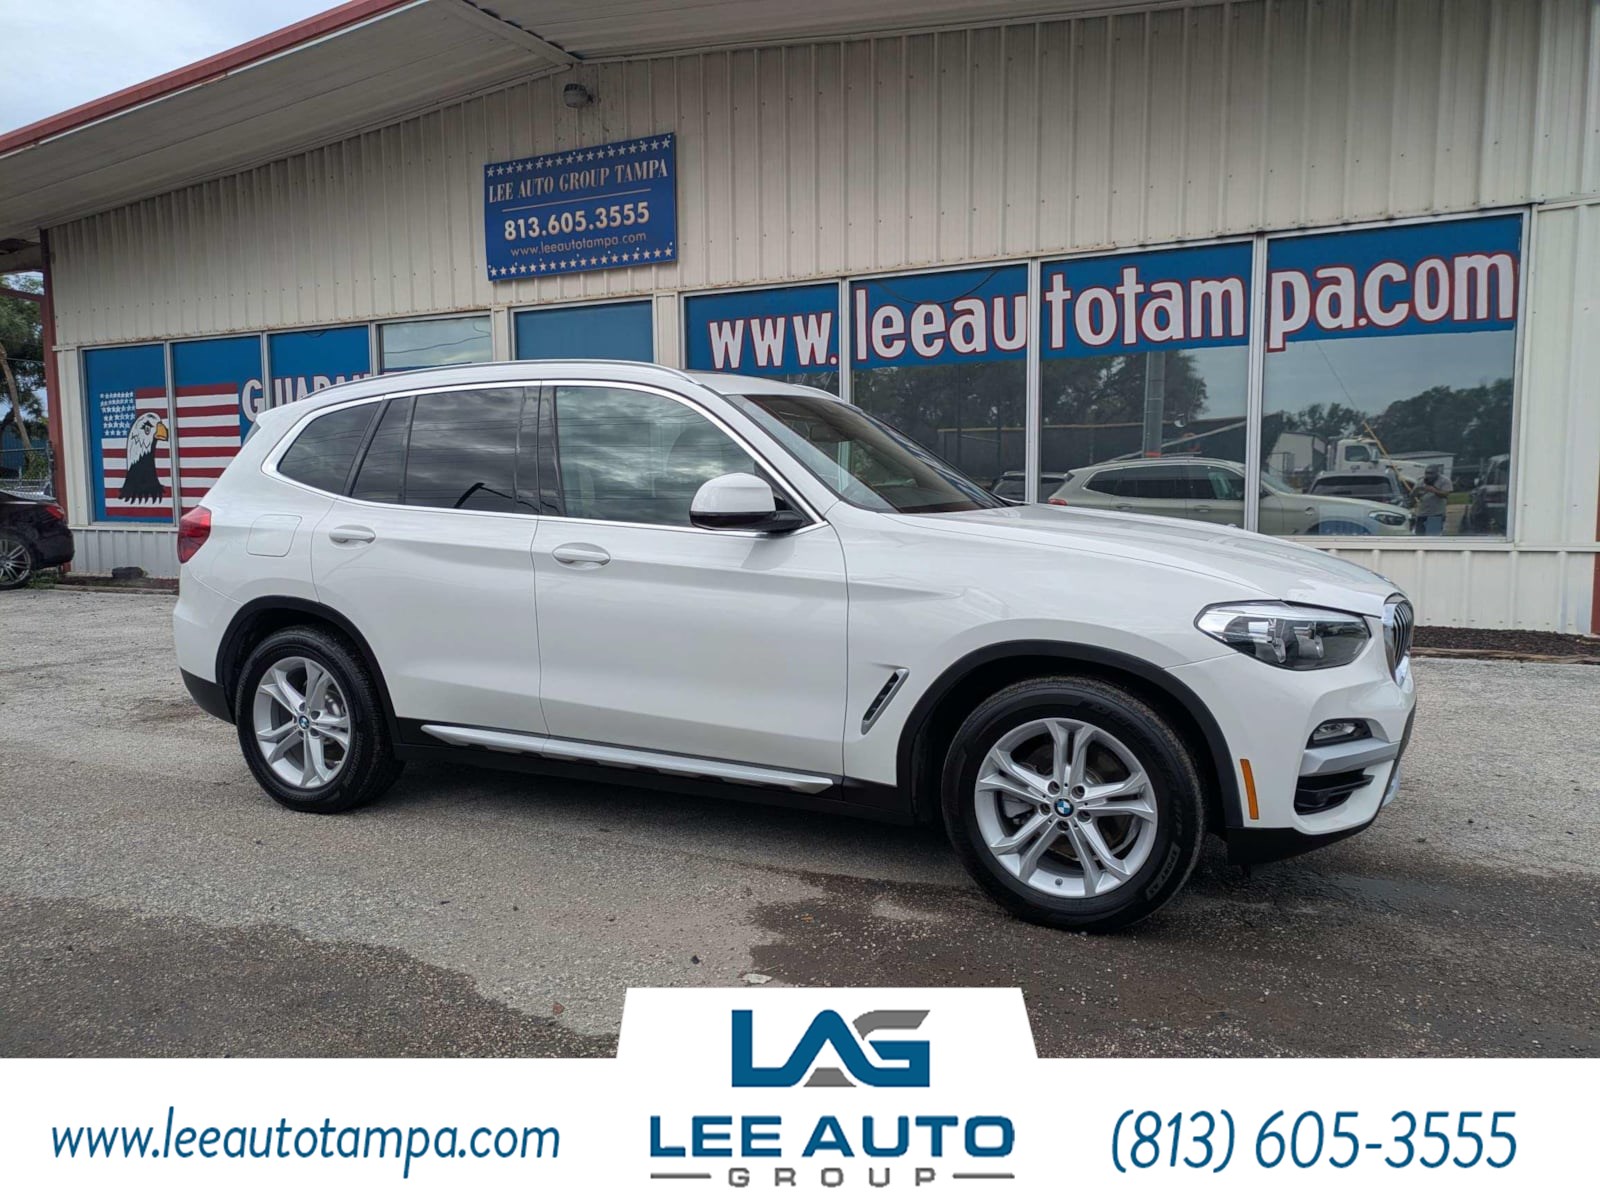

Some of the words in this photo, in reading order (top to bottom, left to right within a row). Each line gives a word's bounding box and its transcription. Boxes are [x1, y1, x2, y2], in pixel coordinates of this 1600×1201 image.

[488, 182, 513, 204] LEE
[517, 176, 554, 199] AUTO
[559, 167, 609, 193] GROUP
[615, 158, 668, 184] TAMPA
[504, 201, 650, 241] 813.605.3555
[510, 232, 647, 257] www.leeautotampa.com
